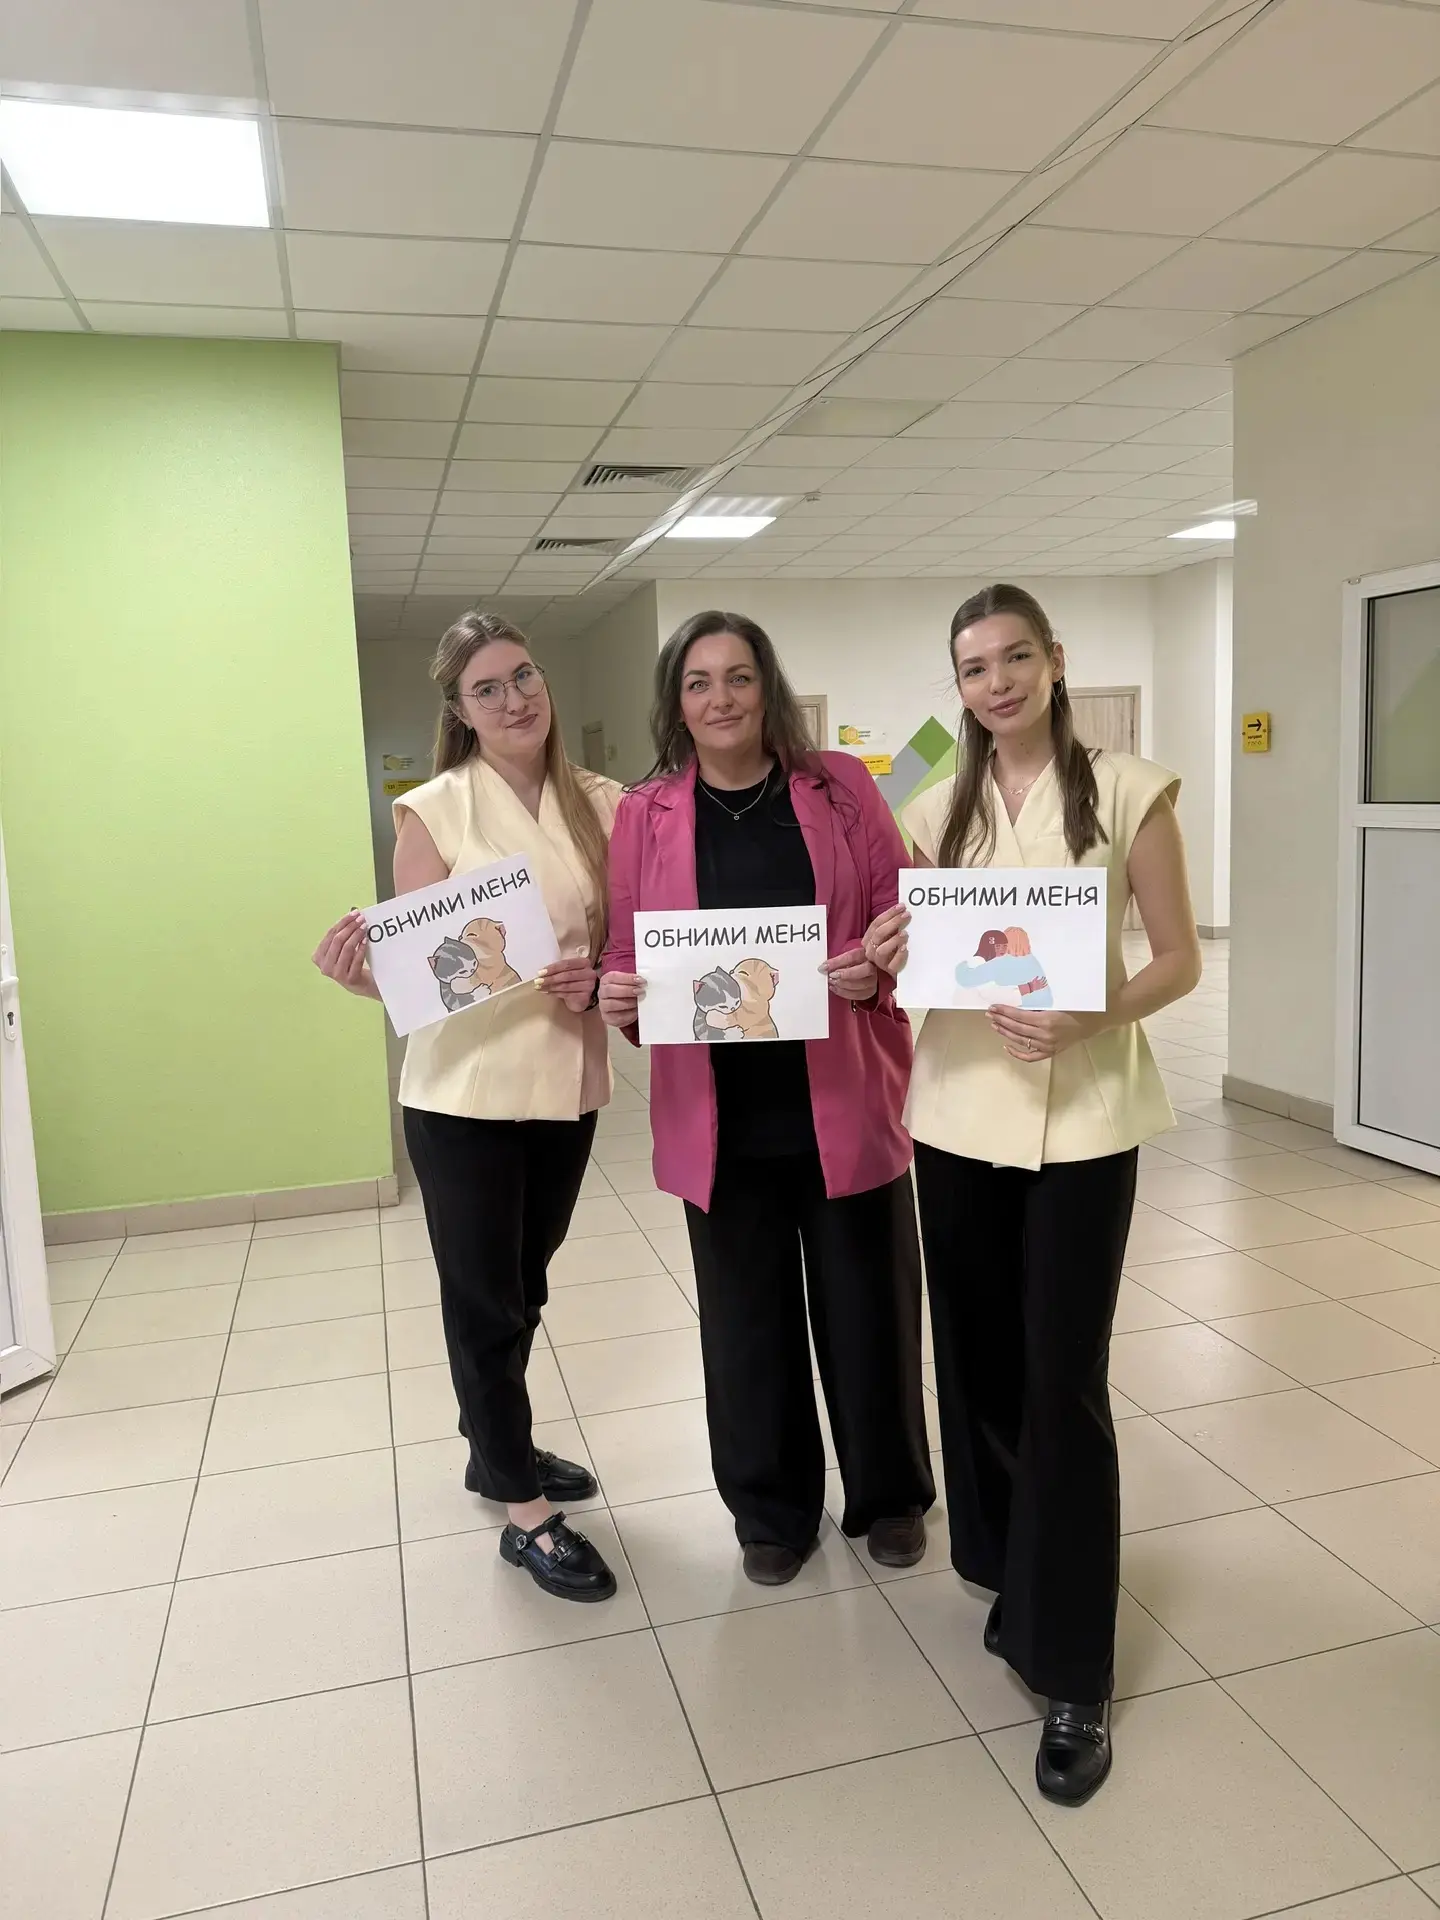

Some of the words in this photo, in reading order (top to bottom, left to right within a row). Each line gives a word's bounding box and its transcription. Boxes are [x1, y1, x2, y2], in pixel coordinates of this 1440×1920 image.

[367, 893, 465, 943] ОБНИМИ
[471, 868, 531, 905] МЕНЯ
[908, 886, 1017, 906] ОБНИМИ
[1026, 886, 1098, 906] МЕНЯ
[644, 926, 747, 948] ОБНИМИ
[755, 923, 821, 944] МЕНЯ
